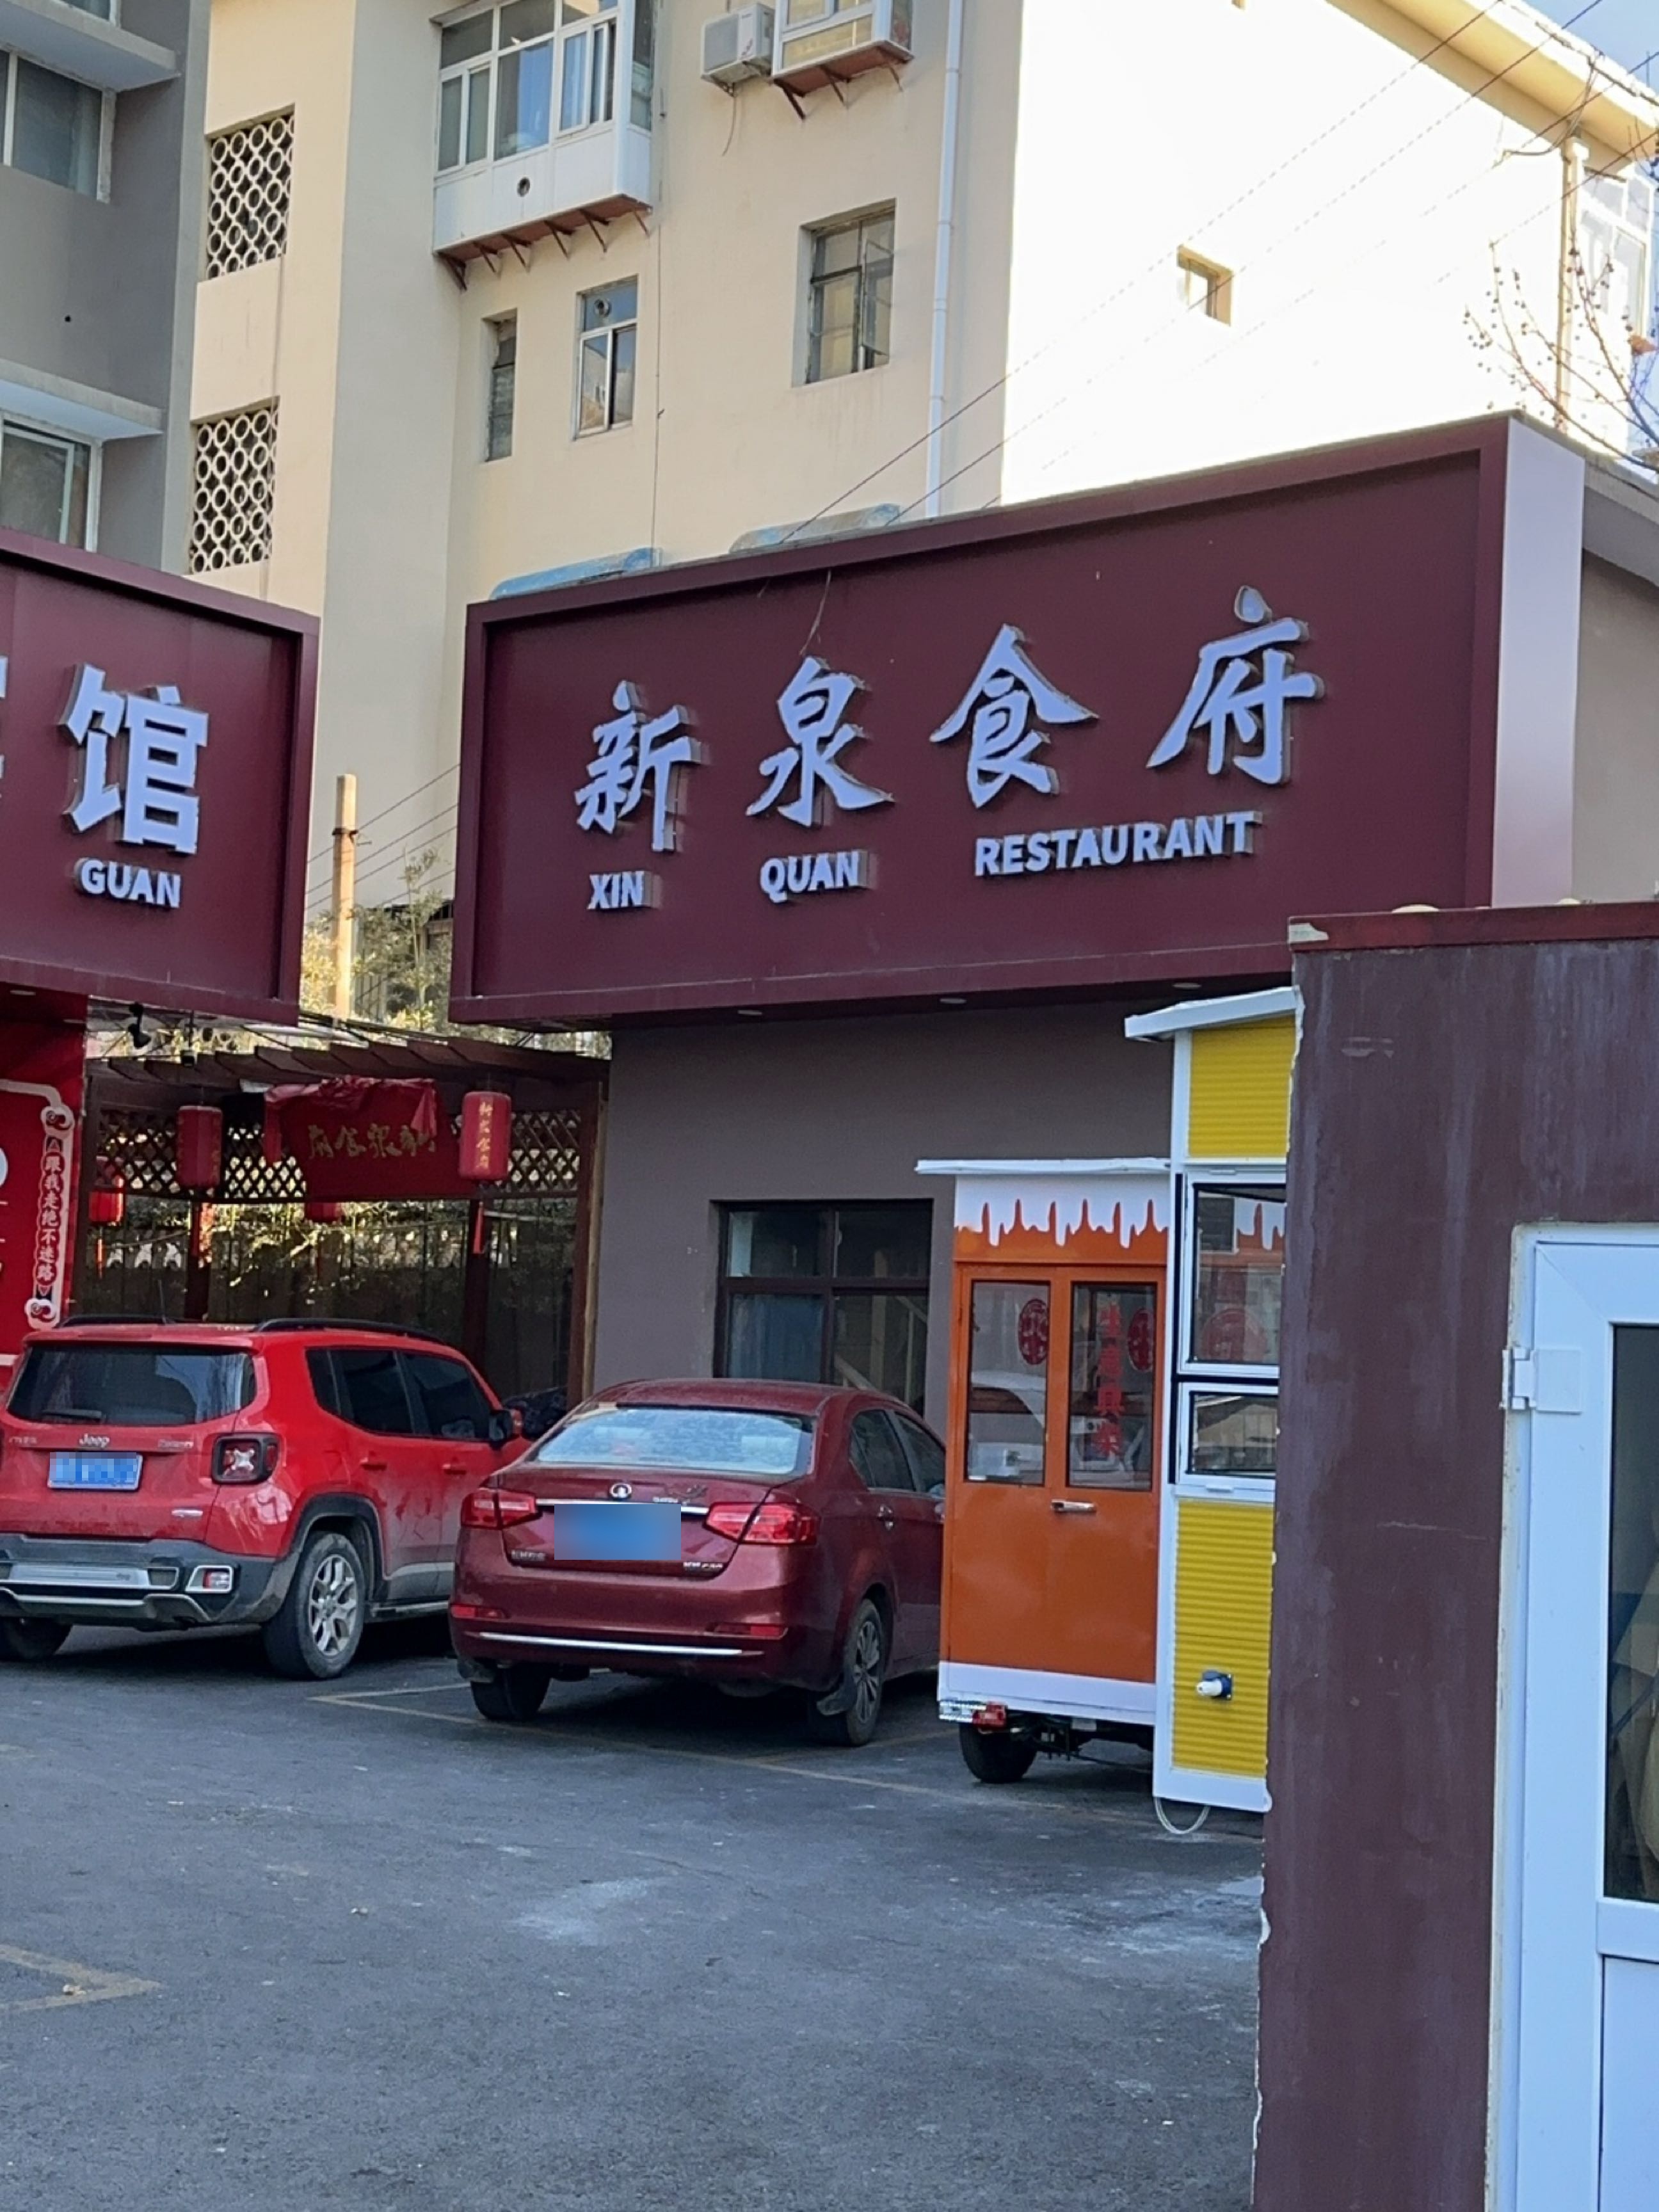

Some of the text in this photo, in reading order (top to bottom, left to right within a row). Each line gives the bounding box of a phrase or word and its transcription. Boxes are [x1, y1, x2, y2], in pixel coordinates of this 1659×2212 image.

[64, 663, 209, 855] 馆
[575, 586, 1324, 852] 新泉食府
[77, 858, 181, 909] GUAN
[588, 810, 1261, 910] XIN QUAN RESTAURANT
[79, 1433, 110, 1448] Jeep
